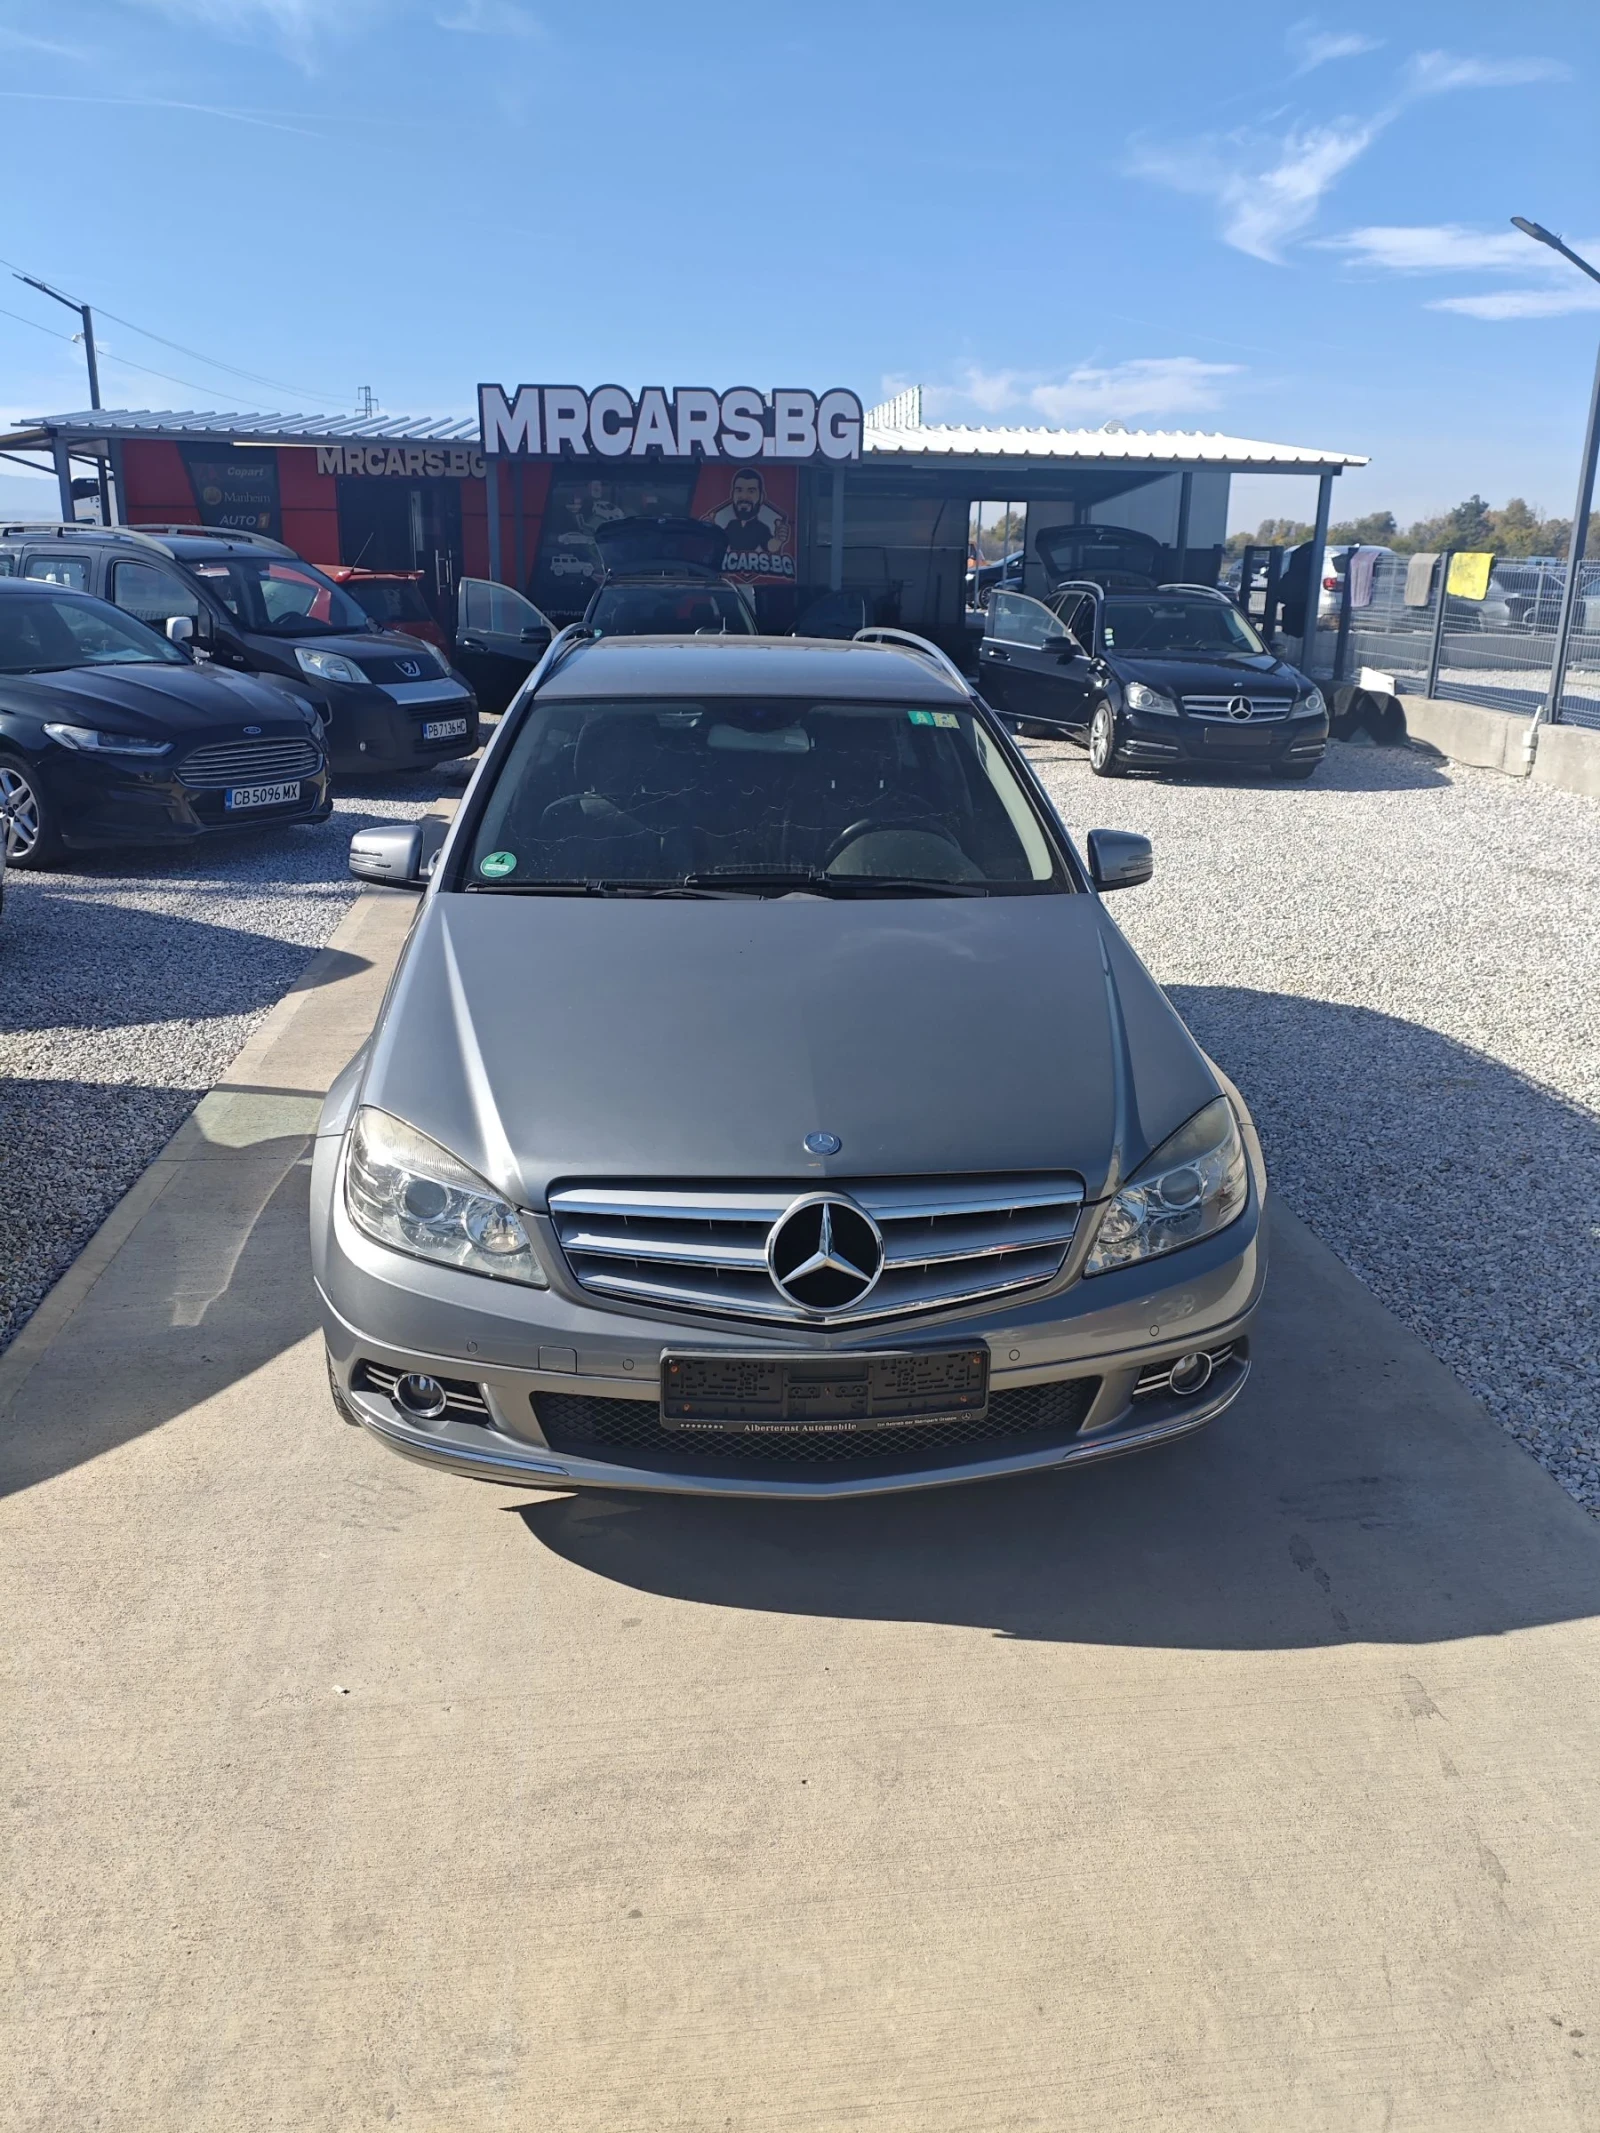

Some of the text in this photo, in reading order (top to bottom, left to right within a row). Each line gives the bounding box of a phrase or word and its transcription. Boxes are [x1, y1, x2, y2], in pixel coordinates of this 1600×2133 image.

[481, 387, 860, 460] MRCARS.BG
[316, 447, 487, 478] MRCARS.BG
[227, 466, 264, 478] Copart
[224, 491, 271, 503] Manheim
[495, 853, 507, 865] 4
[743, 1422, 857, 1432] Alberternst Automobile
